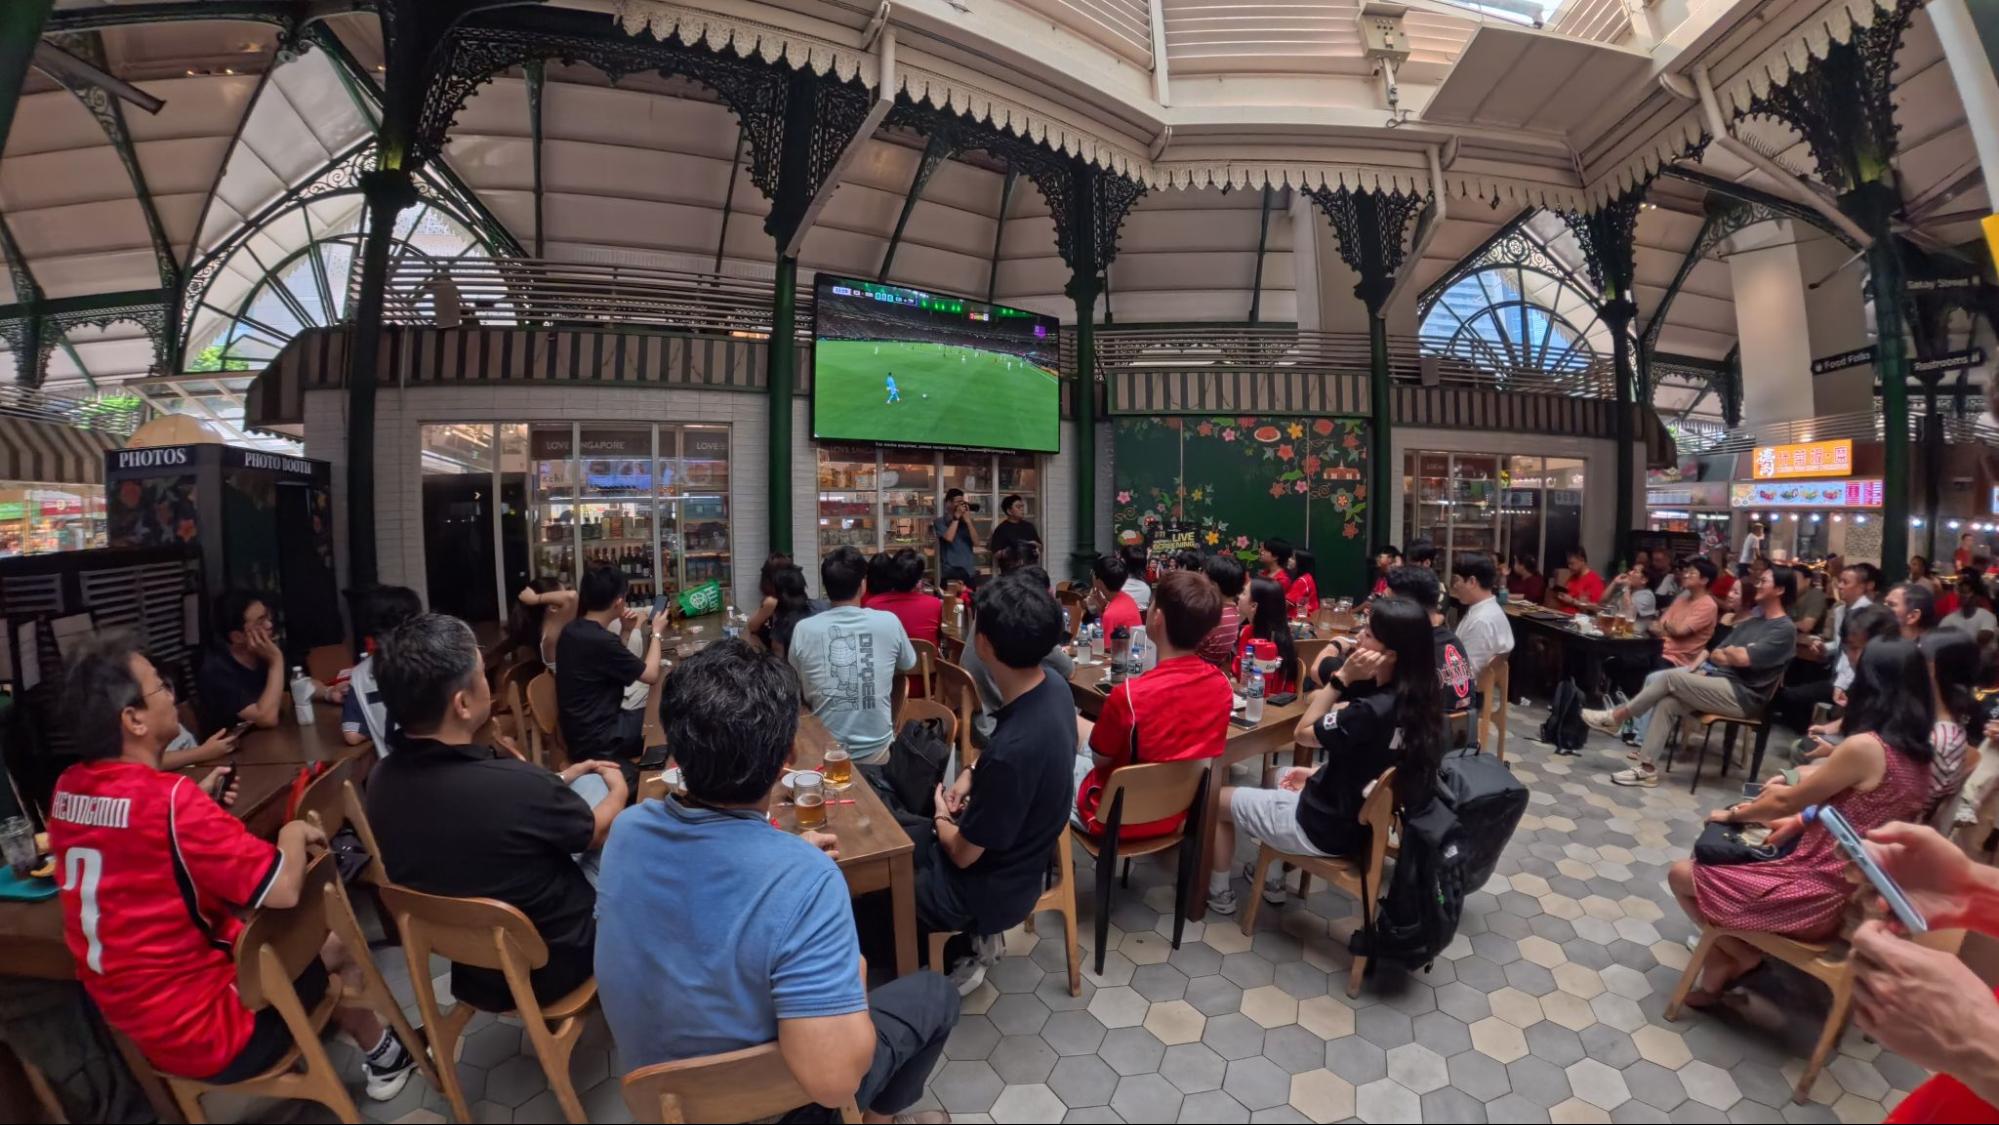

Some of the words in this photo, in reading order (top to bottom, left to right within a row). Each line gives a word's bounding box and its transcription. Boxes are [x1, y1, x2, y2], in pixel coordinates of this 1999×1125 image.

[1937, 278, 1968, 288] Street
[1824, 358, 1847, 369] Food
[546, 441, 569, 450] LOVE
[580, 441, 625, 450] NGAPORE
[119, 447, 187, 468] PHOTOS
[244, 452, 282, 471] PHOTO
[1172, 531, 1195, 542] LIVE
[62, 846, 104, 975] 7
